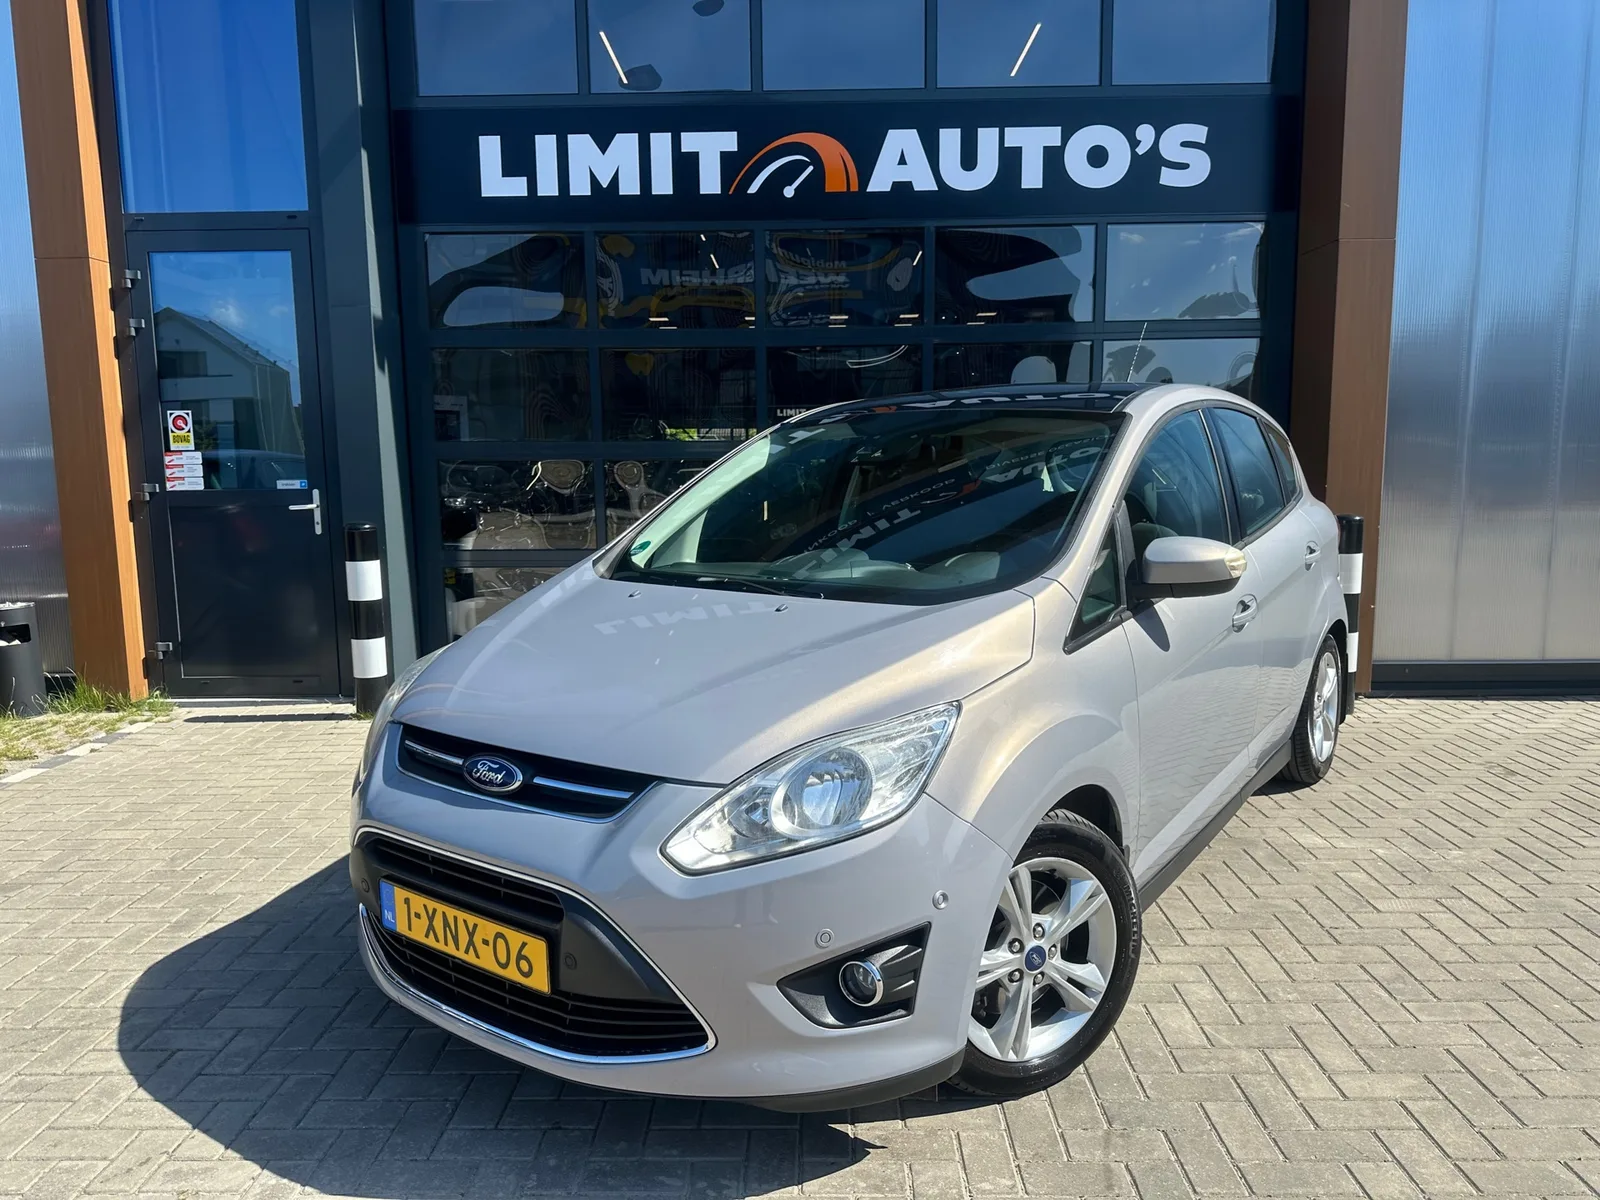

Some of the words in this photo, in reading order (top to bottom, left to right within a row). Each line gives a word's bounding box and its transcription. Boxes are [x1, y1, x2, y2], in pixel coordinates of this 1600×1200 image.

[478, 131, 738, 197] LIMIT
[172, 434, 191, 444] BOVAG
[472, 760, 506, 785] Ford
[384, 909, 395, 923] NL
[403, 897, 534, 979] 1-XNX-06
